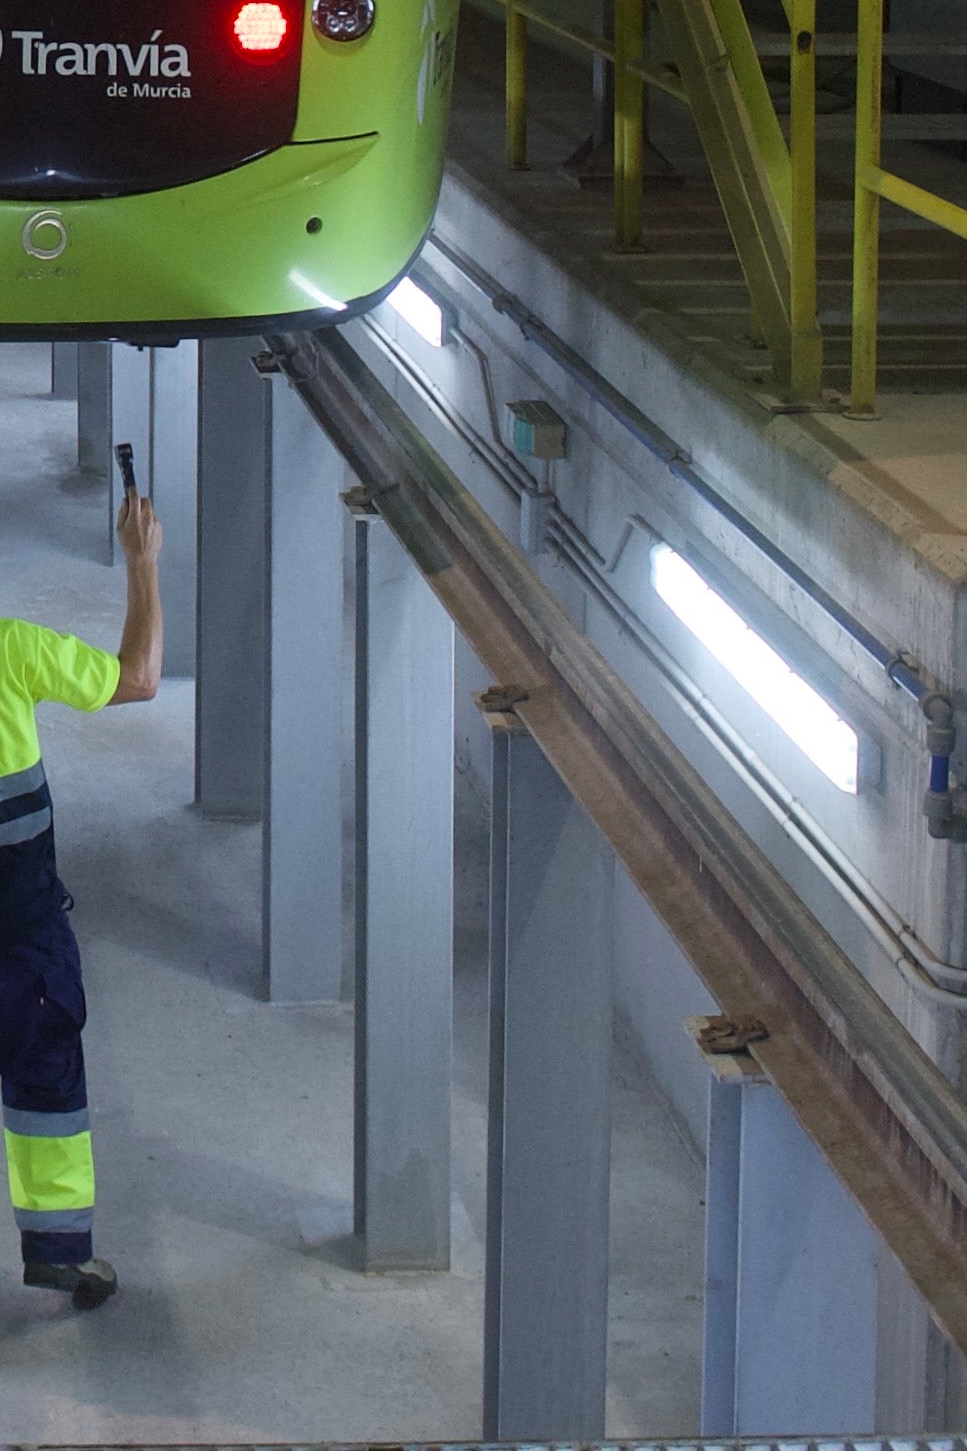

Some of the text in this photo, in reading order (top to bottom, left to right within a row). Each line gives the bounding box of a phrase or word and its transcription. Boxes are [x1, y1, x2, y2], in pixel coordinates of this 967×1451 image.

[11, 29, 192, 77] Tranvía
[106, 82, 192, 99] de Murcia
